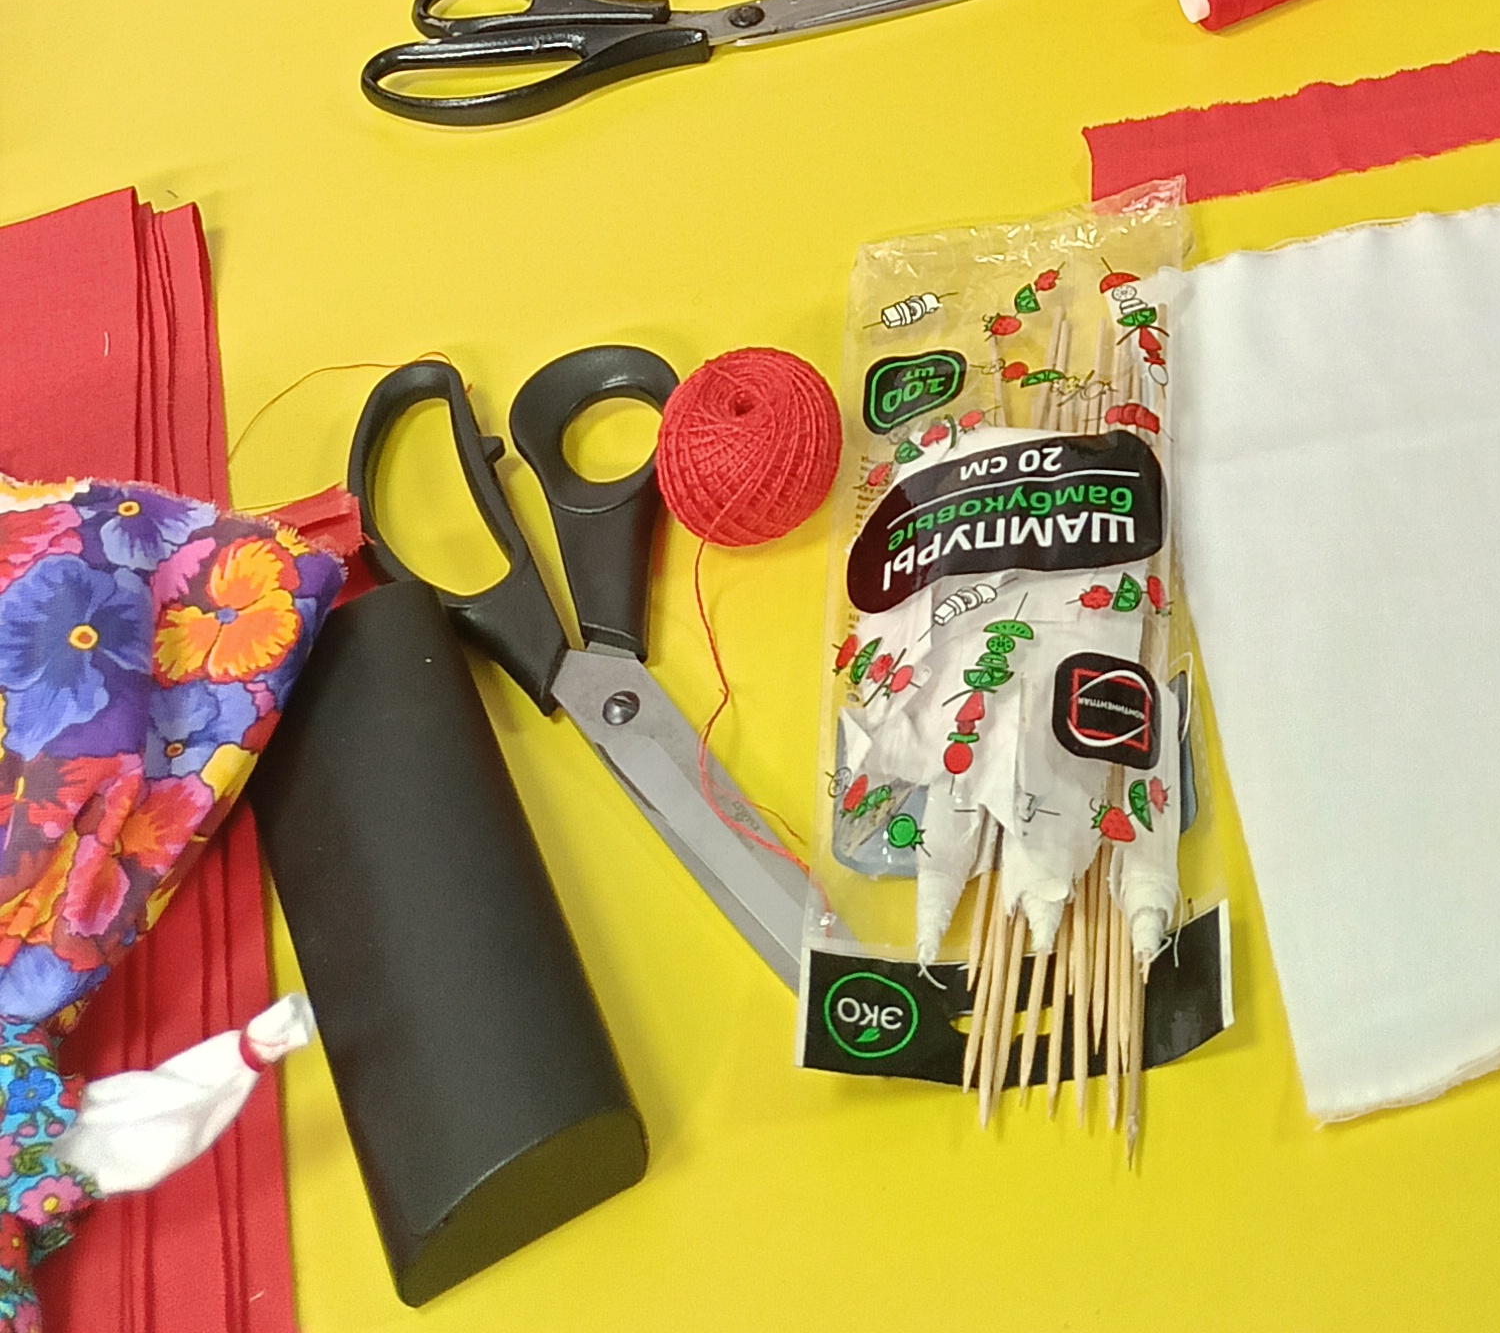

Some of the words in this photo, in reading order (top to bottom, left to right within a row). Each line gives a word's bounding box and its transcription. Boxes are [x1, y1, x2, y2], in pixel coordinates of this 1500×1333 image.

[881, 378, 946, 413] 100
[1017, 446, 1064, 472] 20
[886, 486, 1133, 552] бамбуковые
[882, 513, 1135, 591] ШАМПУРЫ
